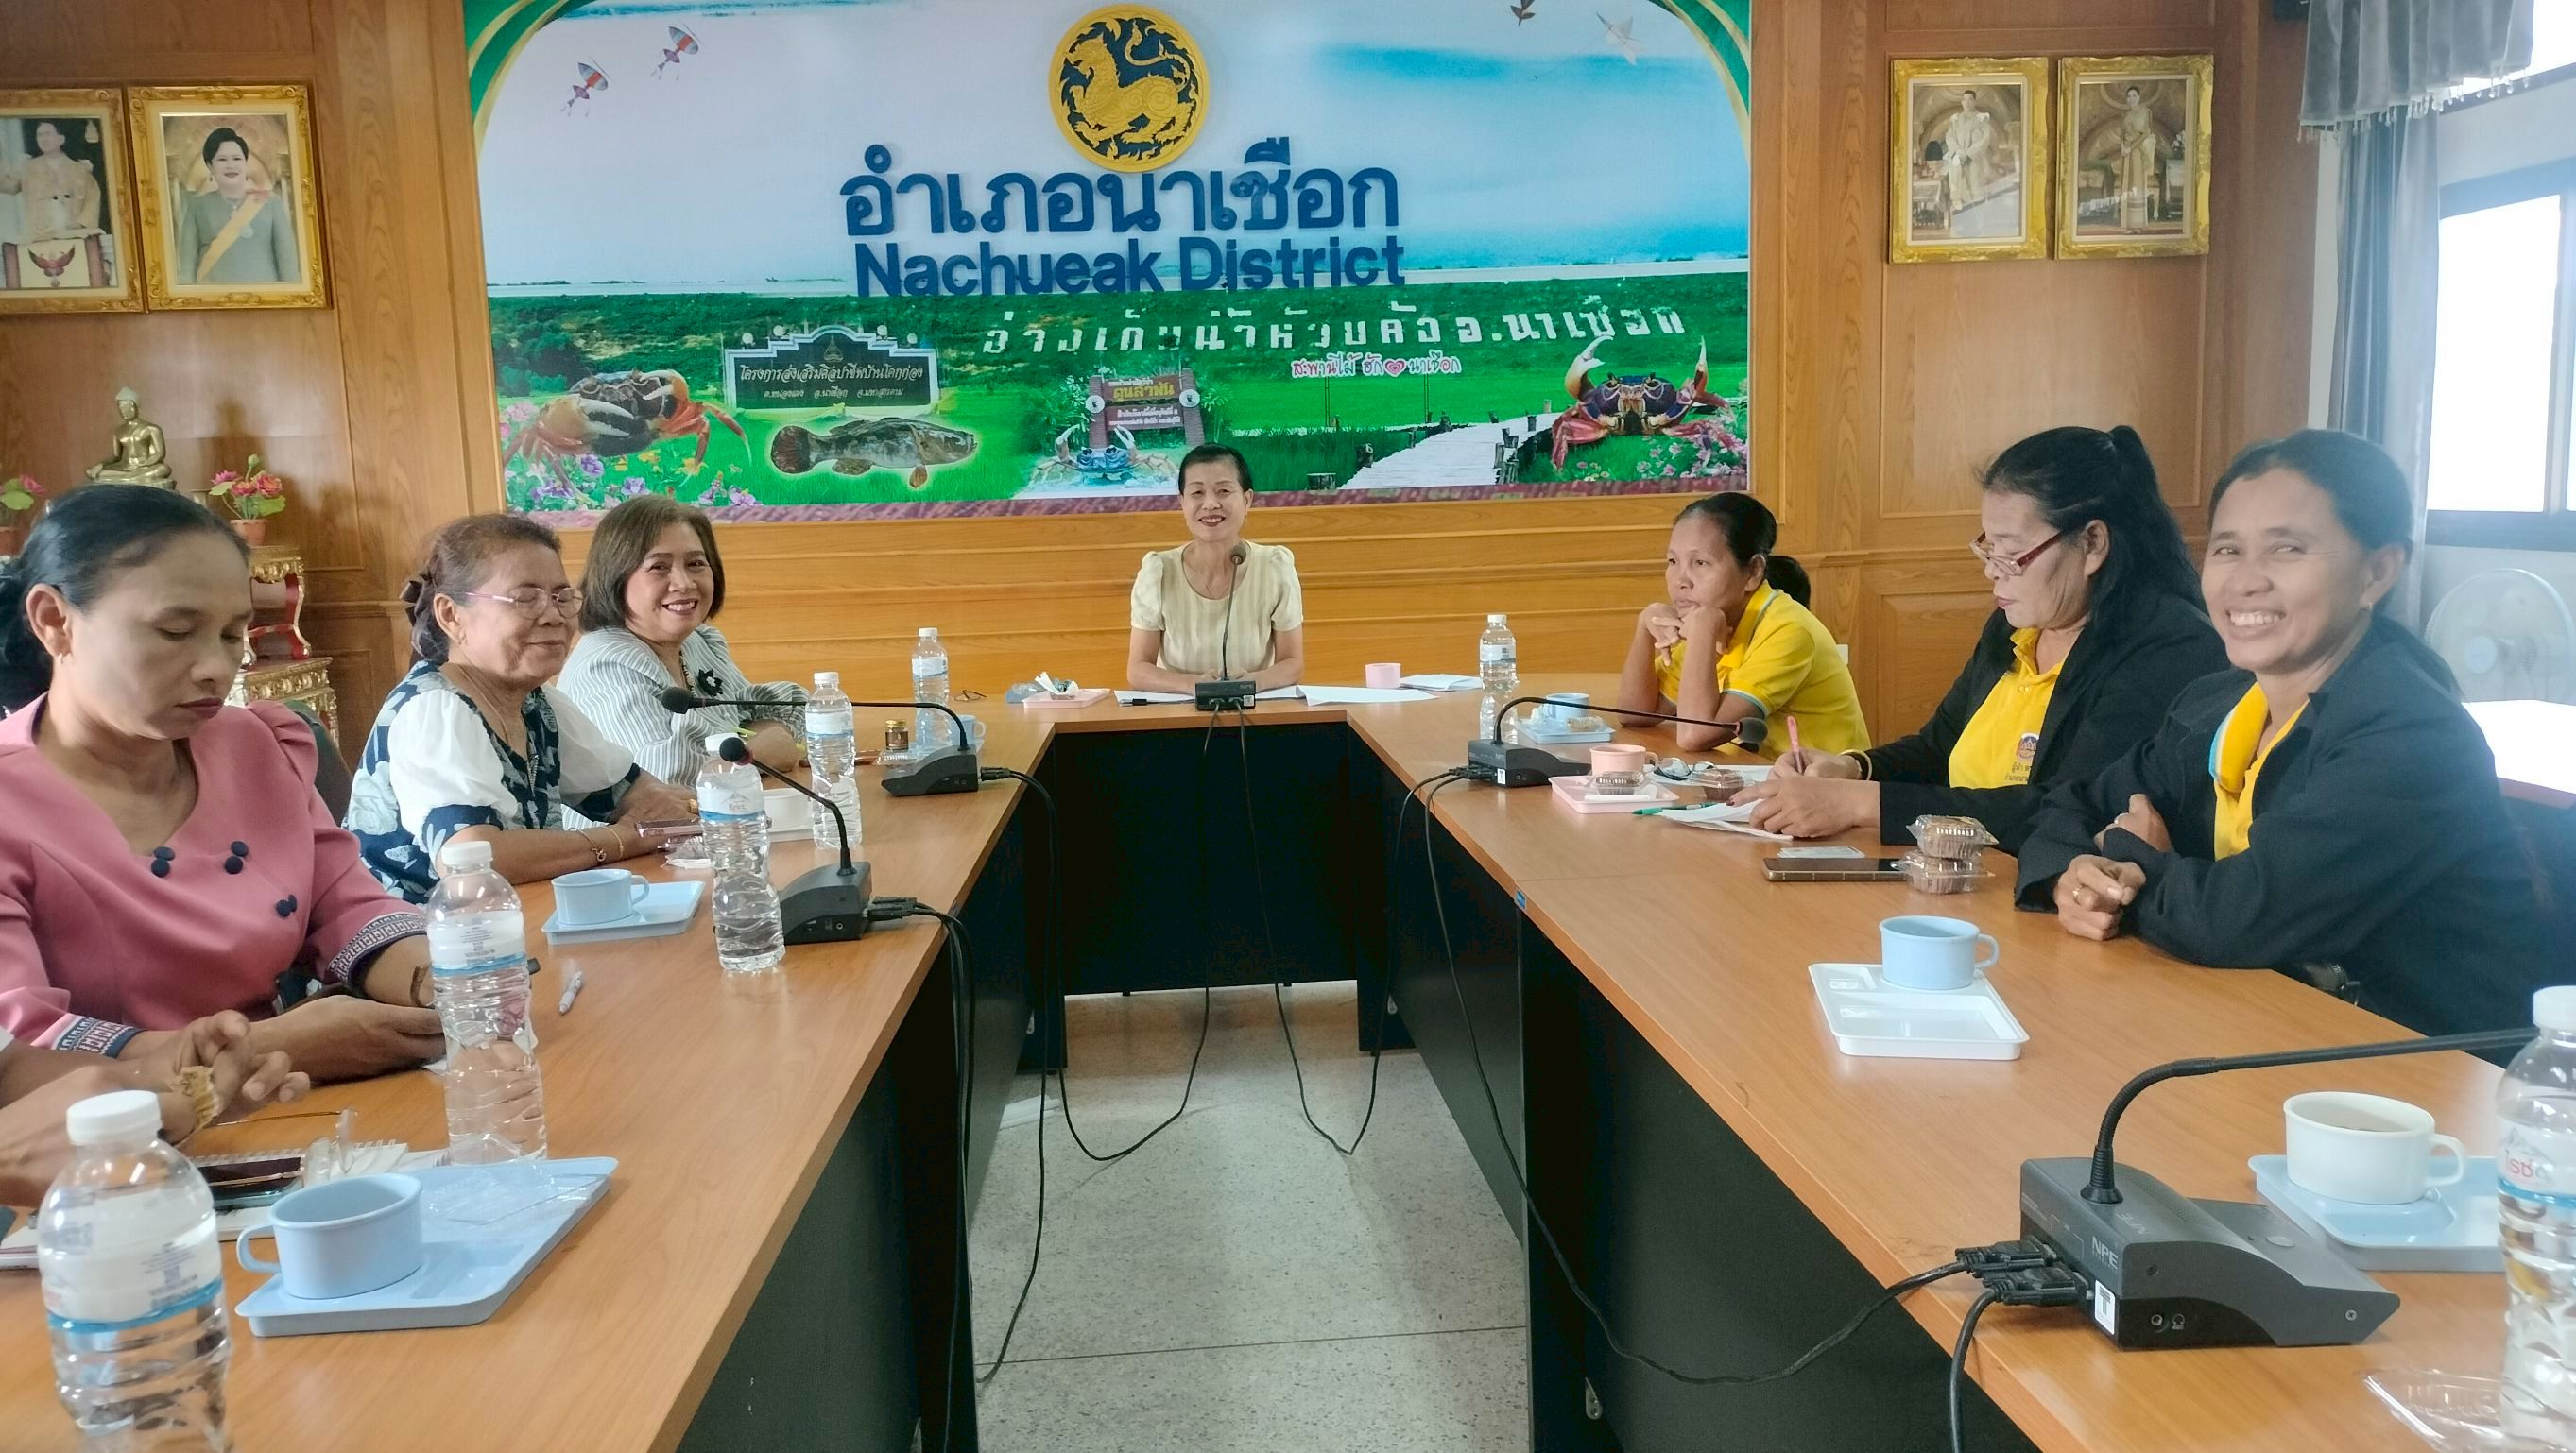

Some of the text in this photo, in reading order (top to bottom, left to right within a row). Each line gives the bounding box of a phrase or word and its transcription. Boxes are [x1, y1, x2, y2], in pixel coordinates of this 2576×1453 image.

[839, 136, 1400, 236] อำเภอนาเชือก
[853, 235, 1406, 298] Nachueak District
[1408, 350, 1462, 375] นาเชือก
[2092, 1236, 2119, 1270] NPE
